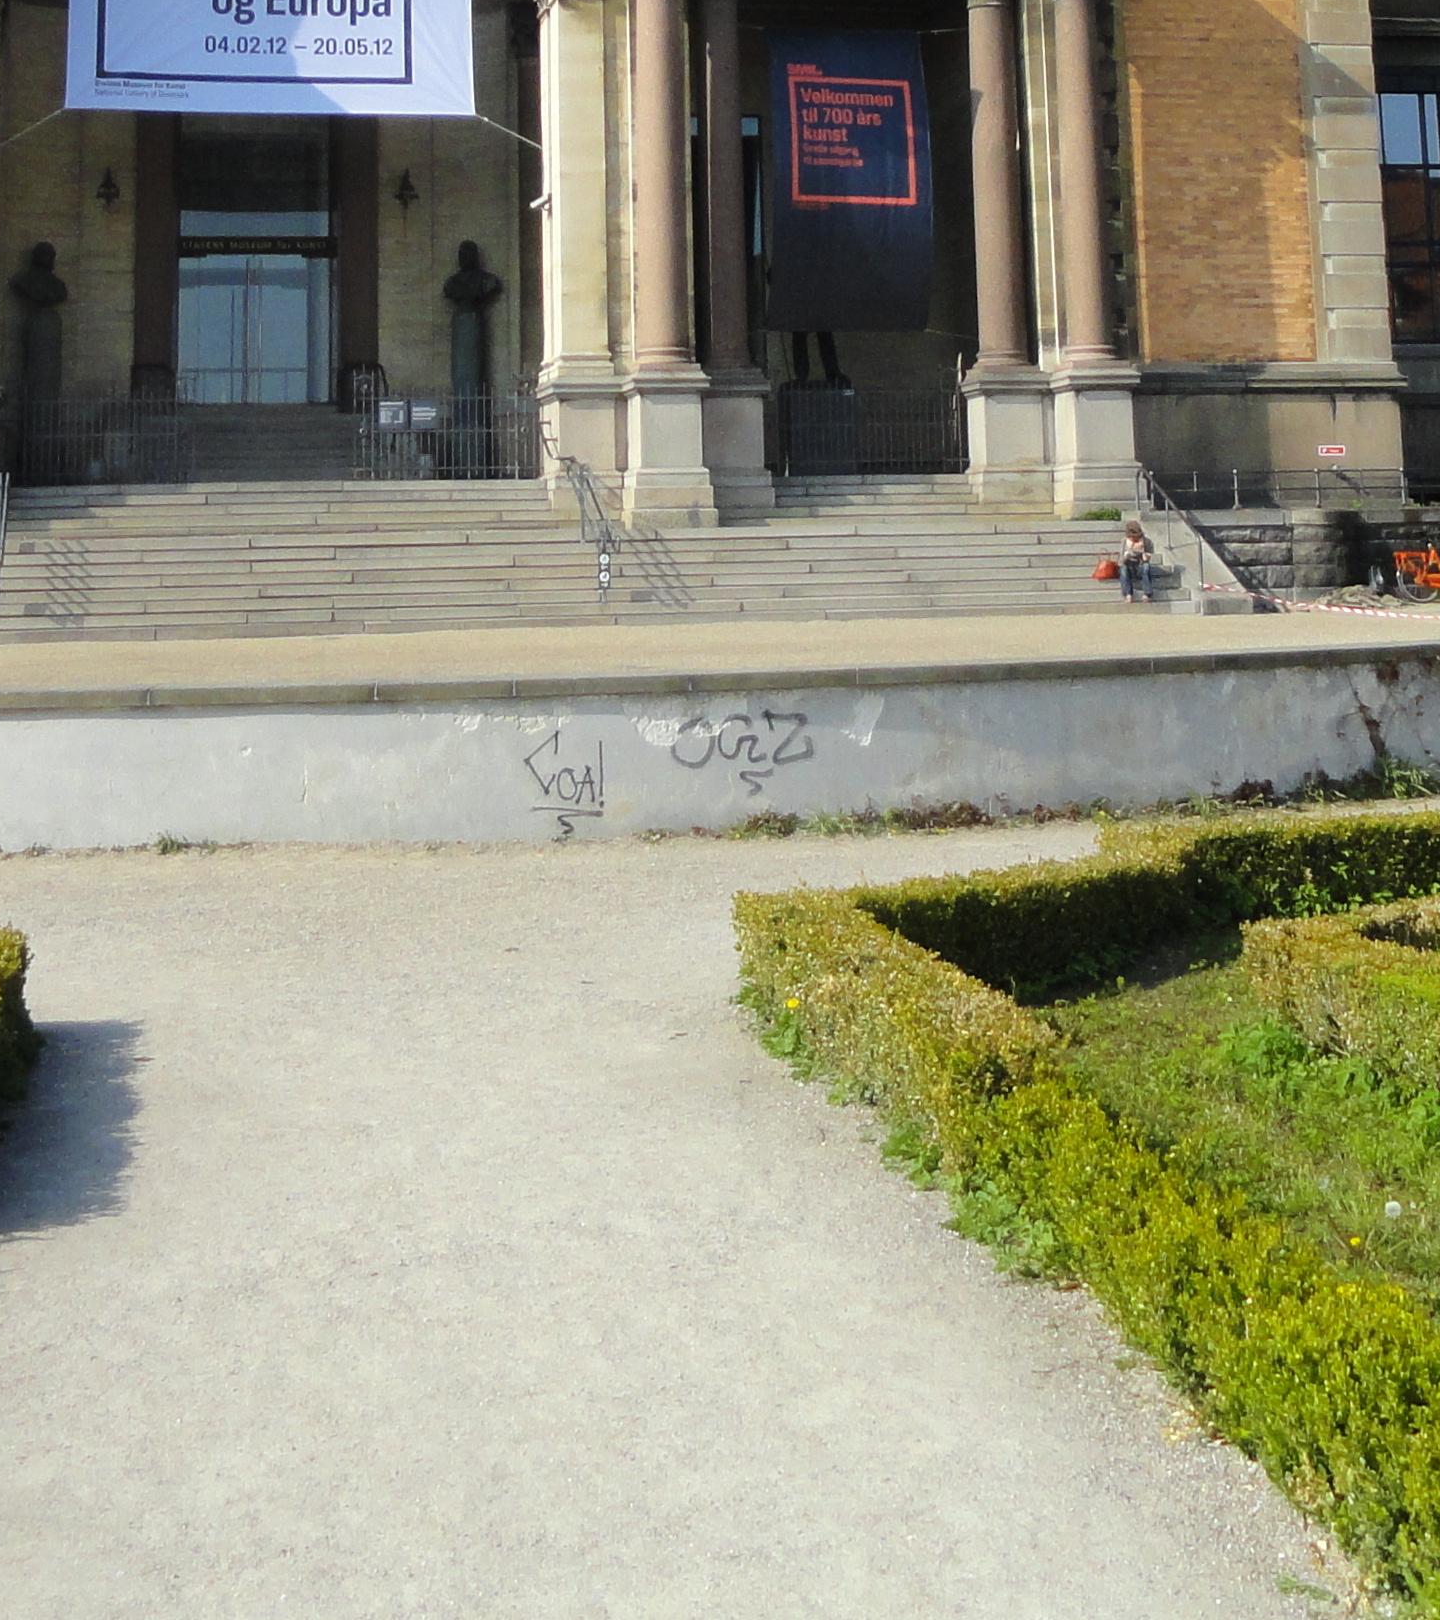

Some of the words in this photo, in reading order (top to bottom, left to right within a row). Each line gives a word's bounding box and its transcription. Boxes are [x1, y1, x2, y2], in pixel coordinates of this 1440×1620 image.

[204, 35, 288, 55] 04.02.12
[313, 37, 394, 56] 20.05.12
[799, 87, 894, 107] Velkommen
[801, 107, 818, 123] til
[823, 107, 853, 125] 700
[855, 108, 882, 126] års
[803, 124, 848, 142] kunst
